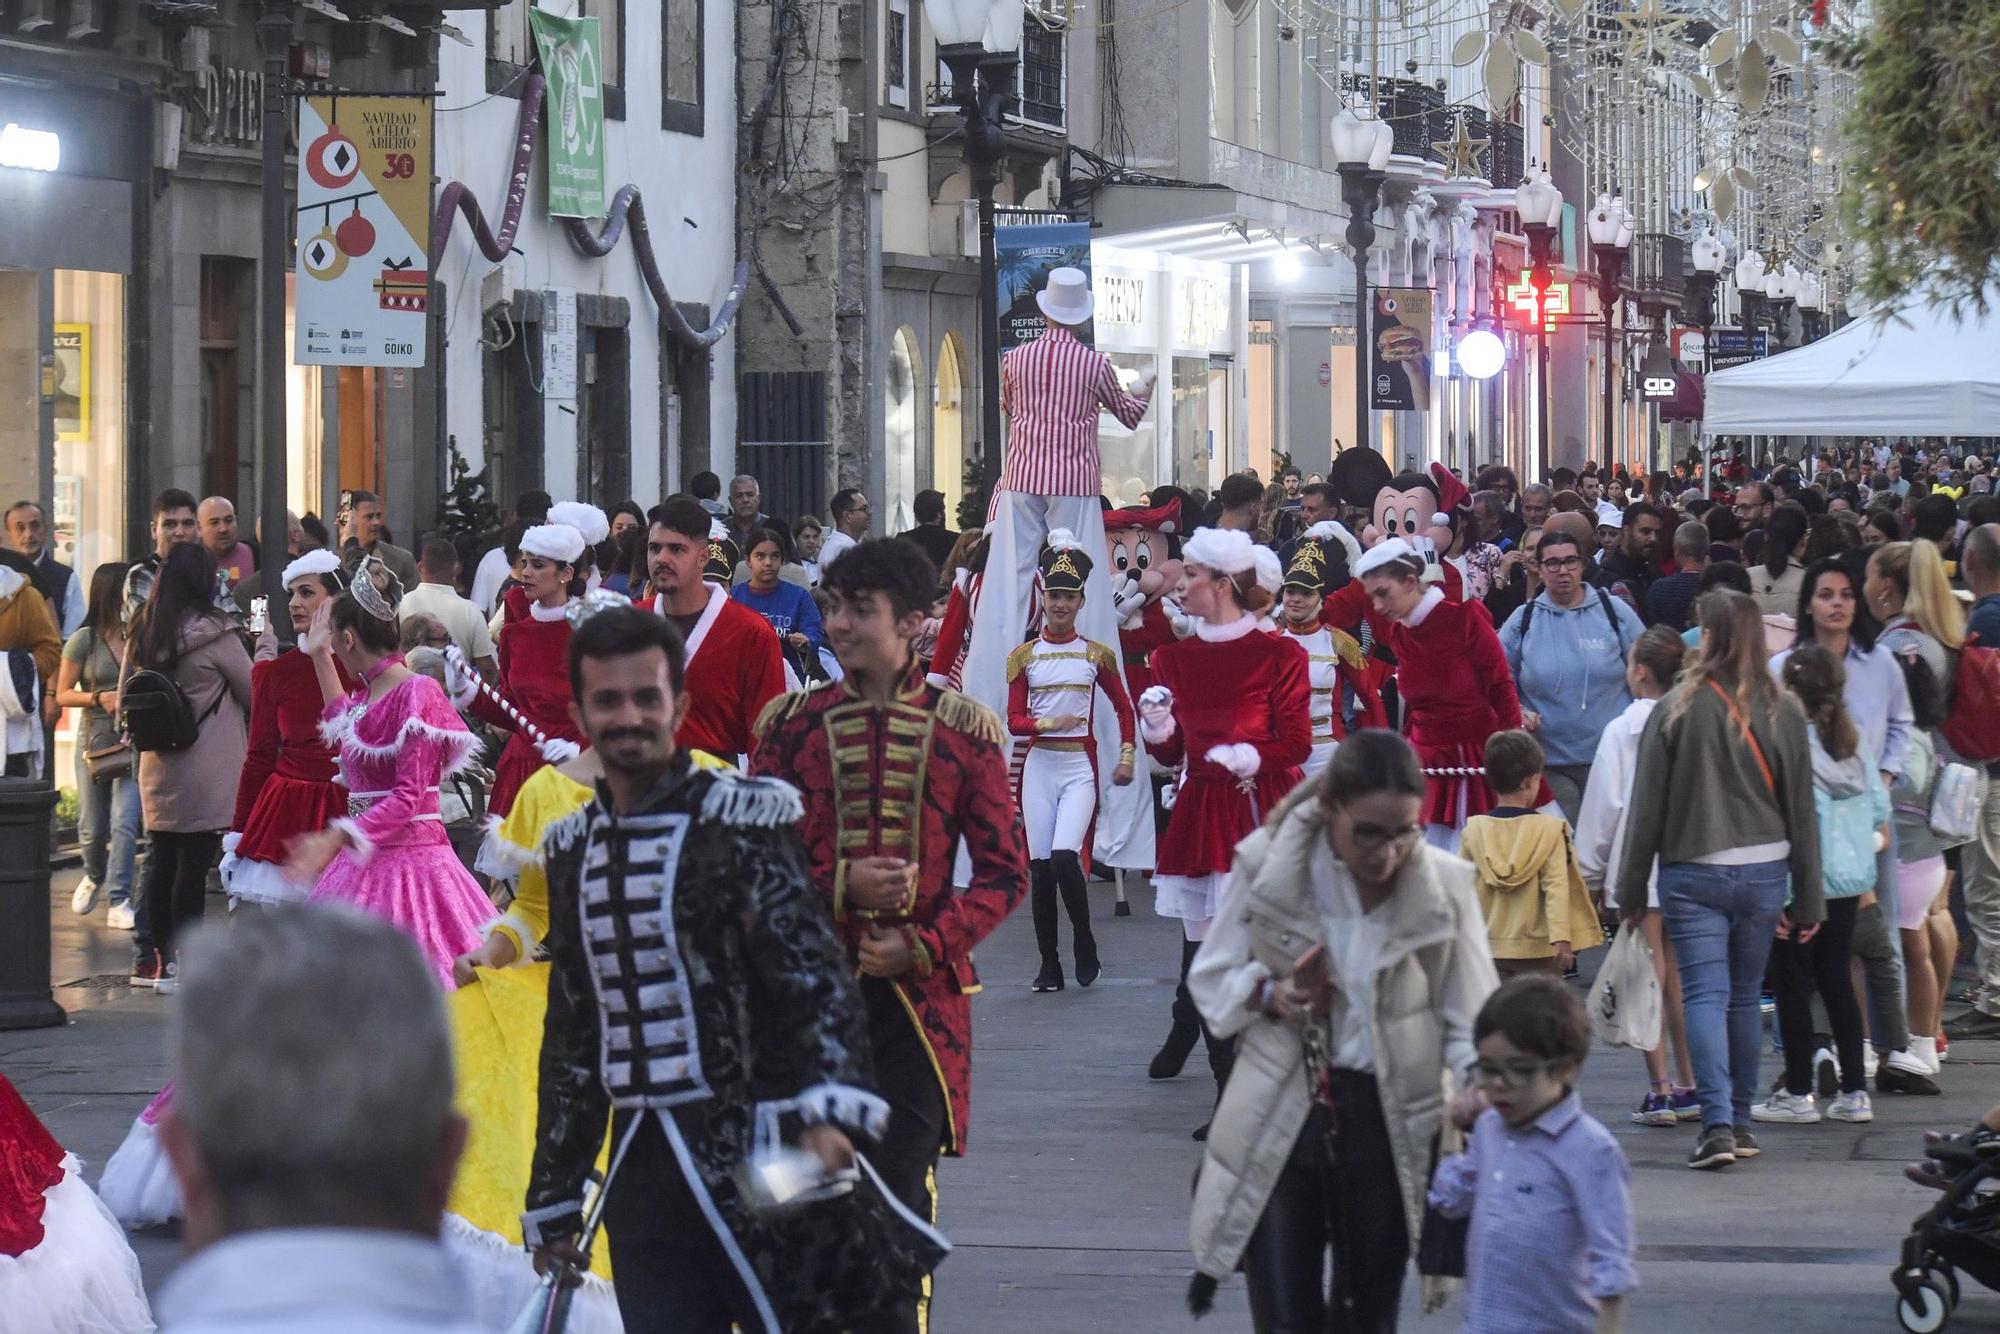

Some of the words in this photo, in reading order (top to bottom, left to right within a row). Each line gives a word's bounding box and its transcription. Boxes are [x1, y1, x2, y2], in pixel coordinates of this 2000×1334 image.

[362, 111, 417, 125] NAVIDAD
[377, 125, 410, 137] CIELO
[368, 137, 417, 150] ABIERTO
[382, 153, 415, 179] 30
[1022, 246, 1066, 257] CHESTER
[384, 343, 413, 355] GOIKO
[1713, 355, 1753, 366] UNIVERSITY
